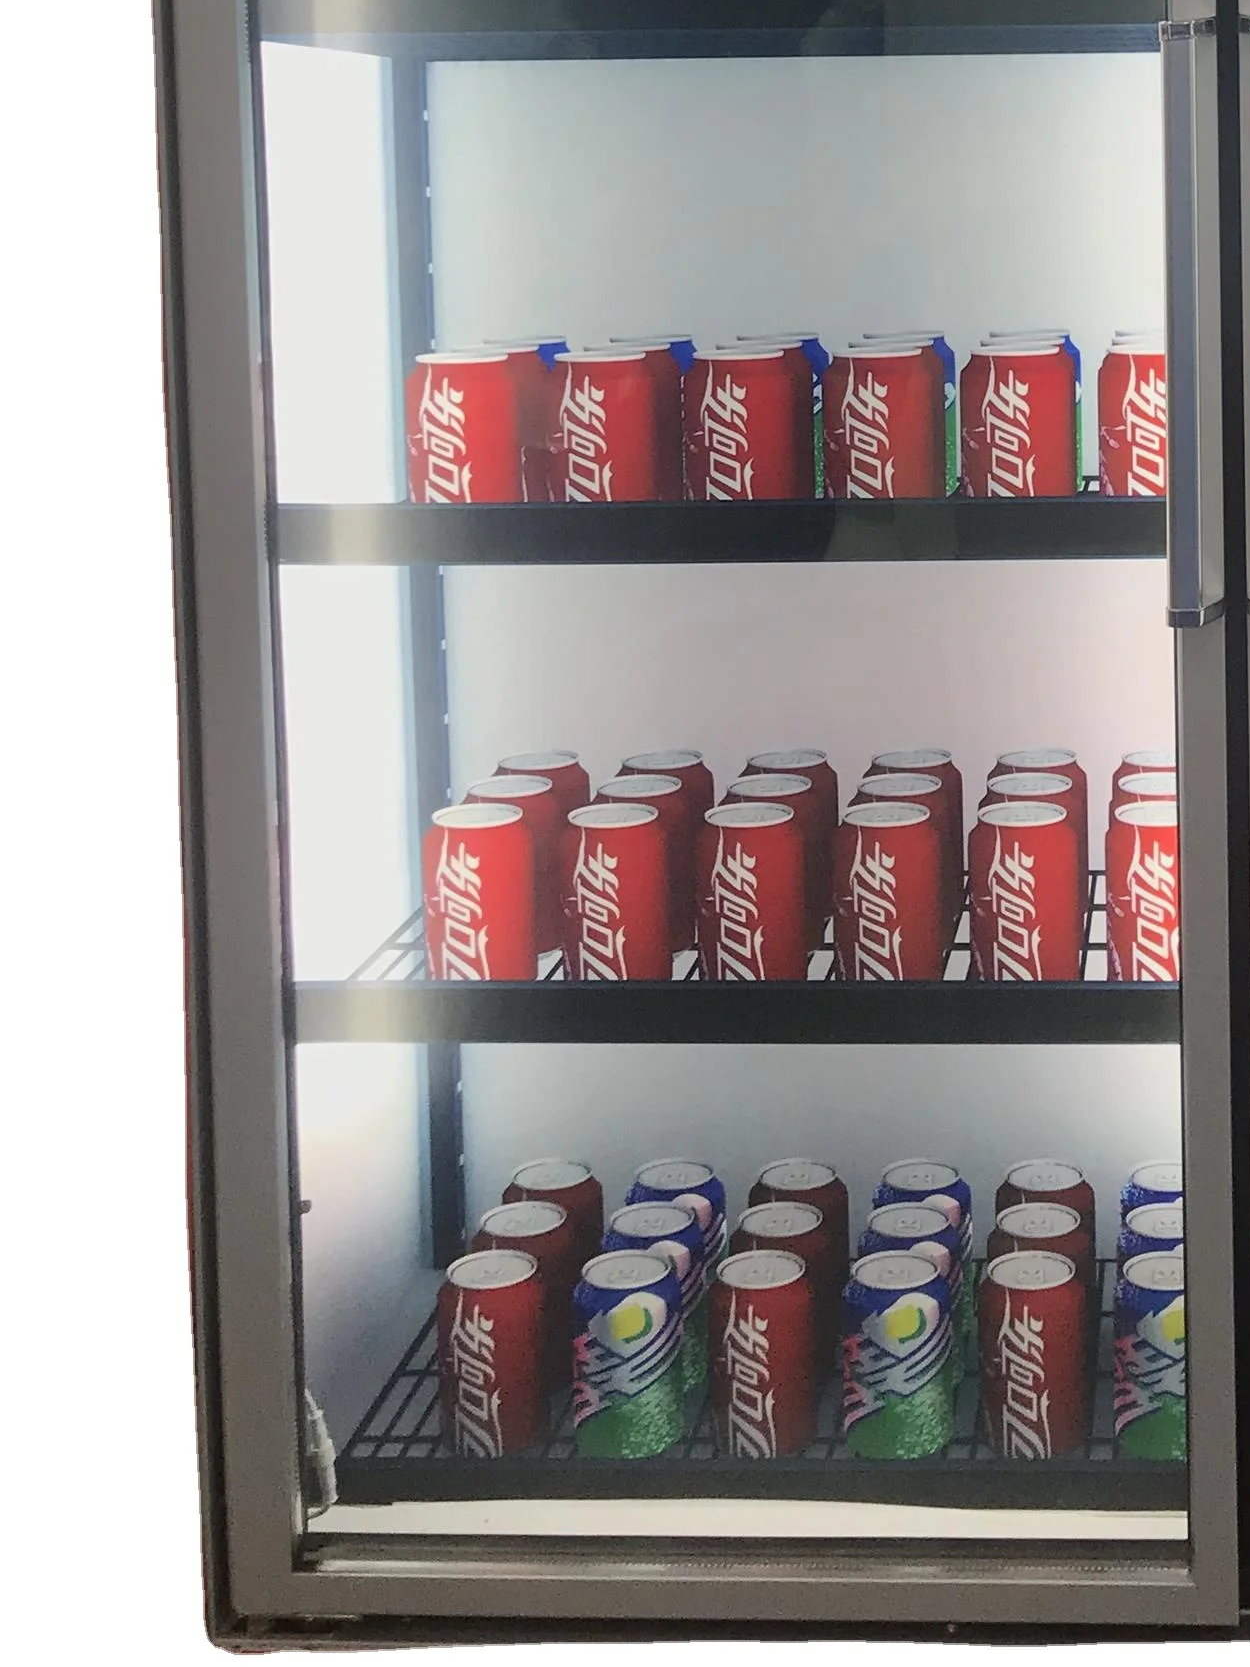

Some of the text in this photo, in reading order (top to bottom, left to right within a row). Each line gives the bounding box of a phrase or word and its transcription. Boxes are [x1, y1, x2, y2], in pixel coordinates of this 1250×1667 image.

[451, 1289, 499, 1458] 可口可乐
[723, 1289, 770, 1458] 可口可乐
[998, 1288, 1046, 1459] 可口可乐
